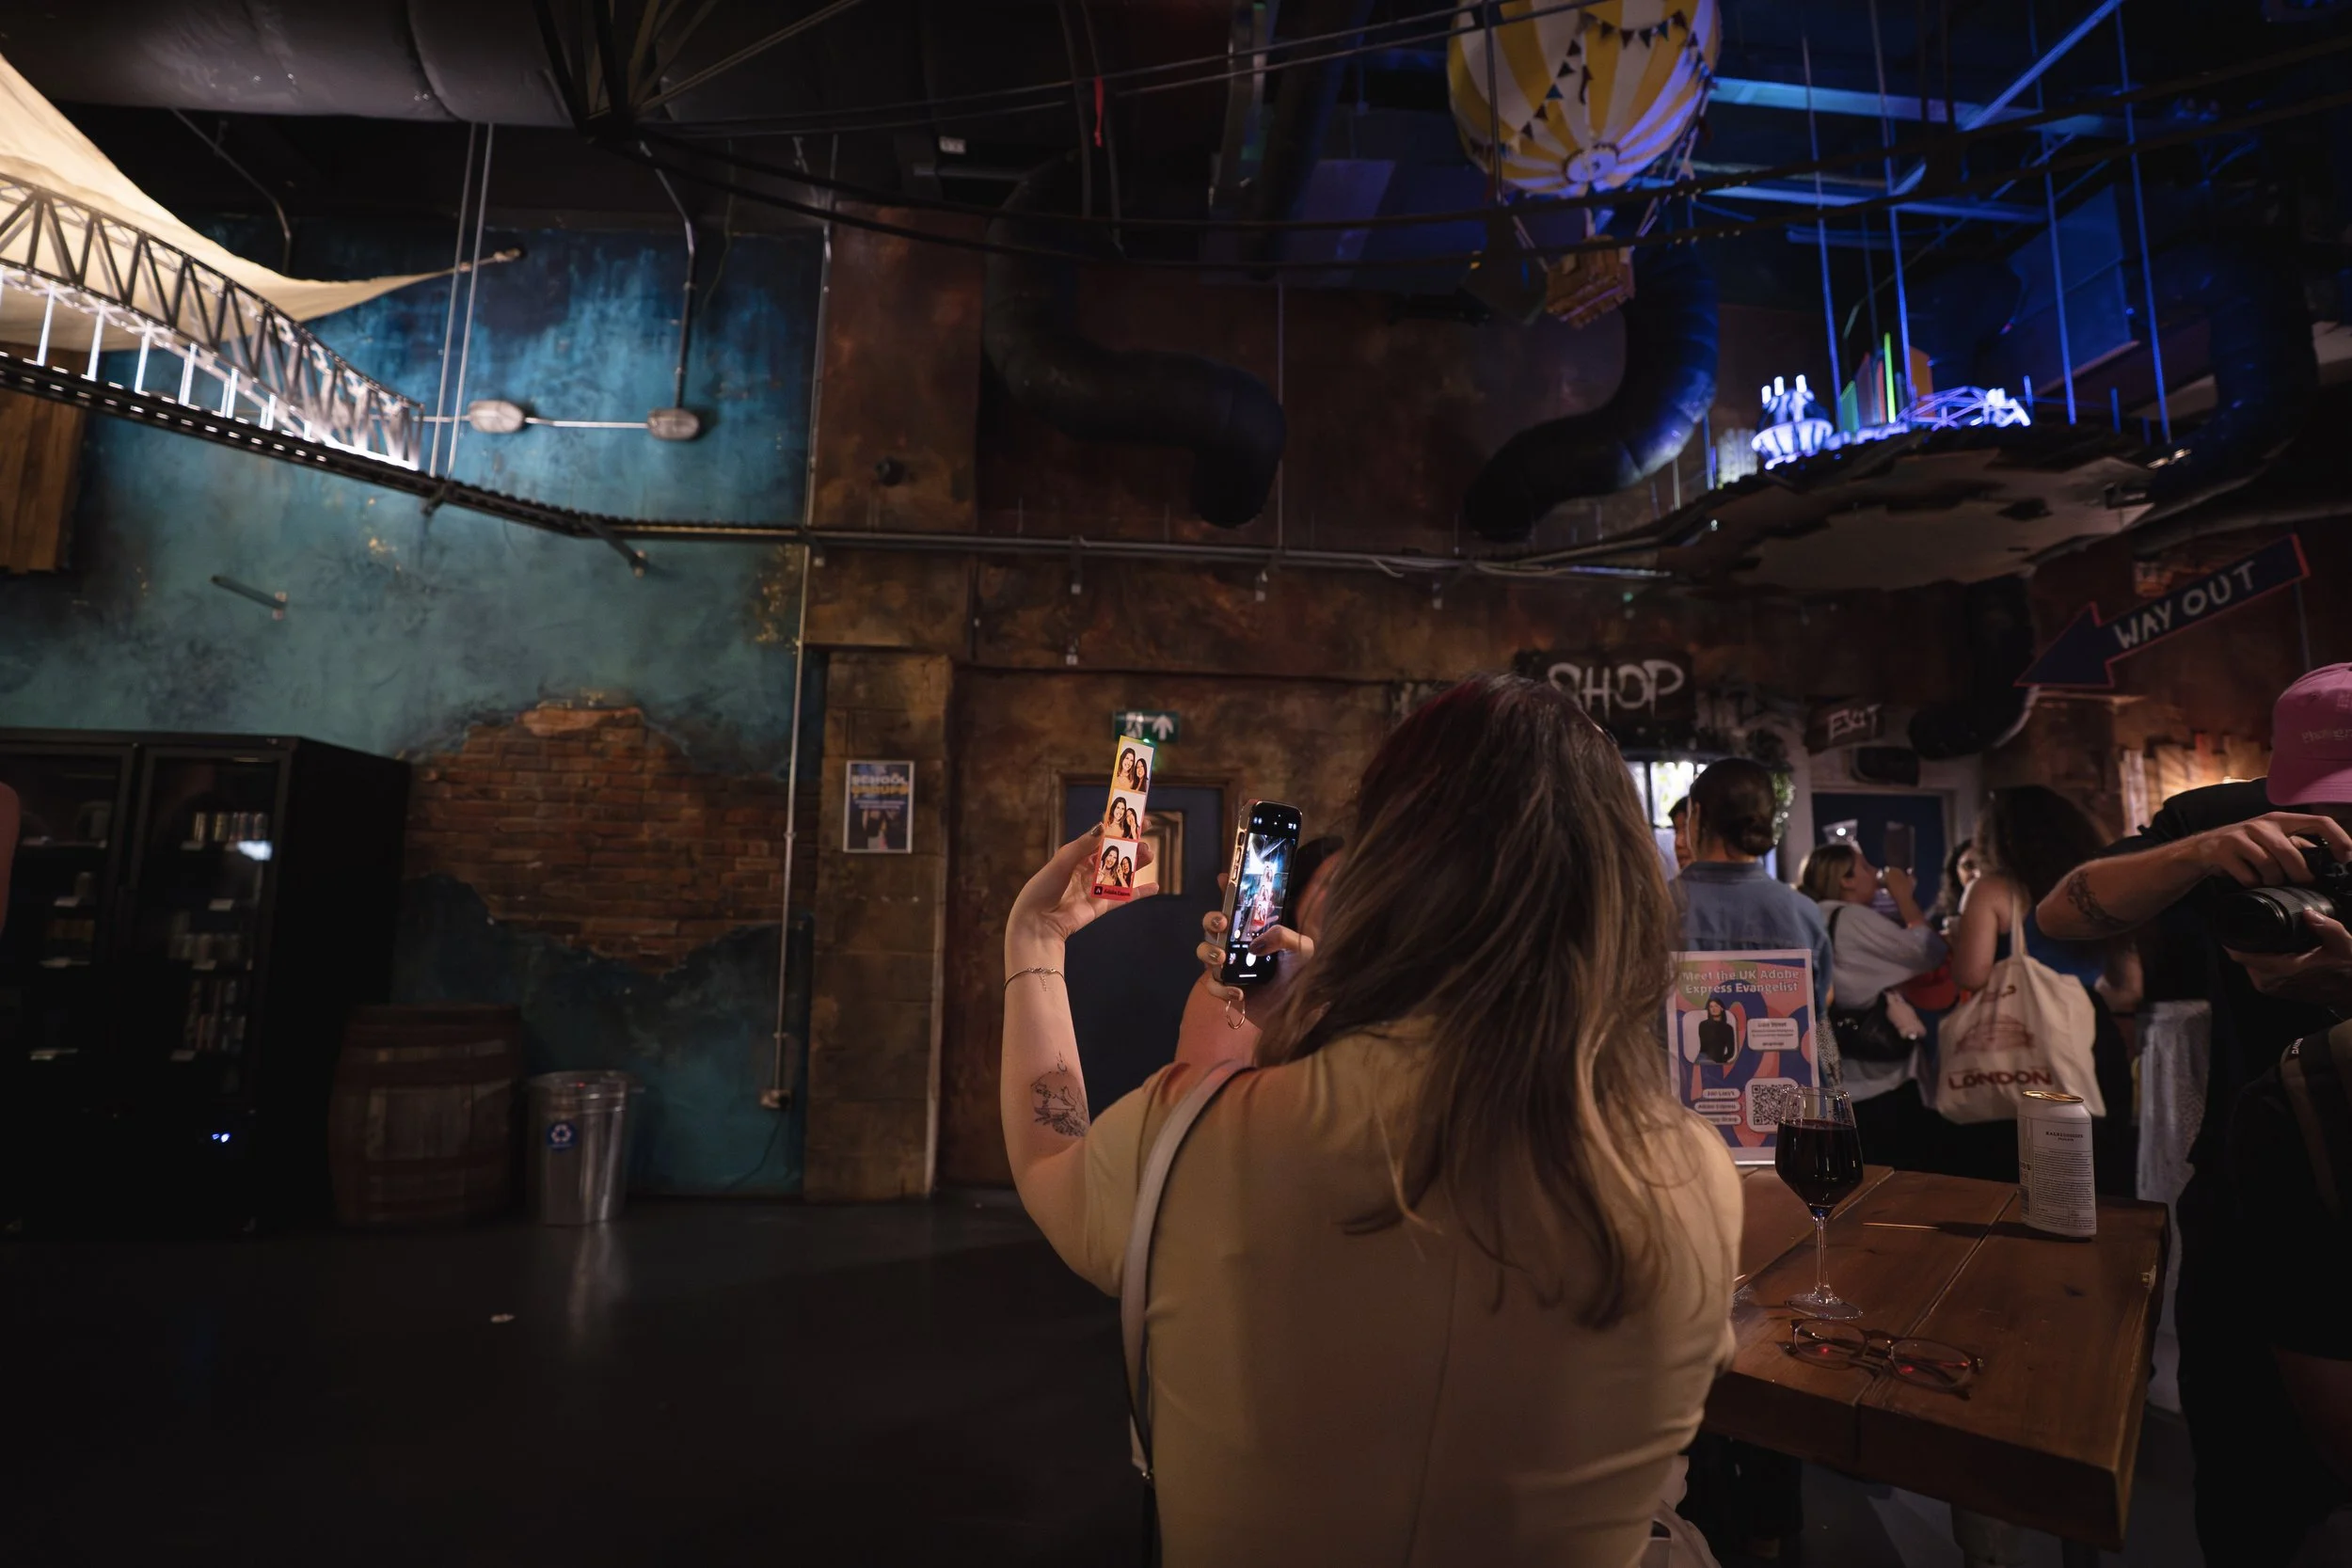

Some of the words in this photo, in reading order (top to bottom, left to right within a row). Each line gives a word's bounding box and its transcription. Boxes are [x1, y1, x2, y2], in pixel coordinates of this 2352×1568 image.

[2112, 600, 2172, 649] WAY
[2182, 561, 2256, 616] OUT
[1682, 972, 1712, 981] Meet
[1716, 970, 1737, 980] the
[1740, 970, 1756, 979] UK
[1760, 969, 1800, 979] Adobe
[1686, 984, 1733, 996] Express
[1735, 982, 1798, 994] Evangelist
[1948, 1069, 2053, 1090] LONDON
